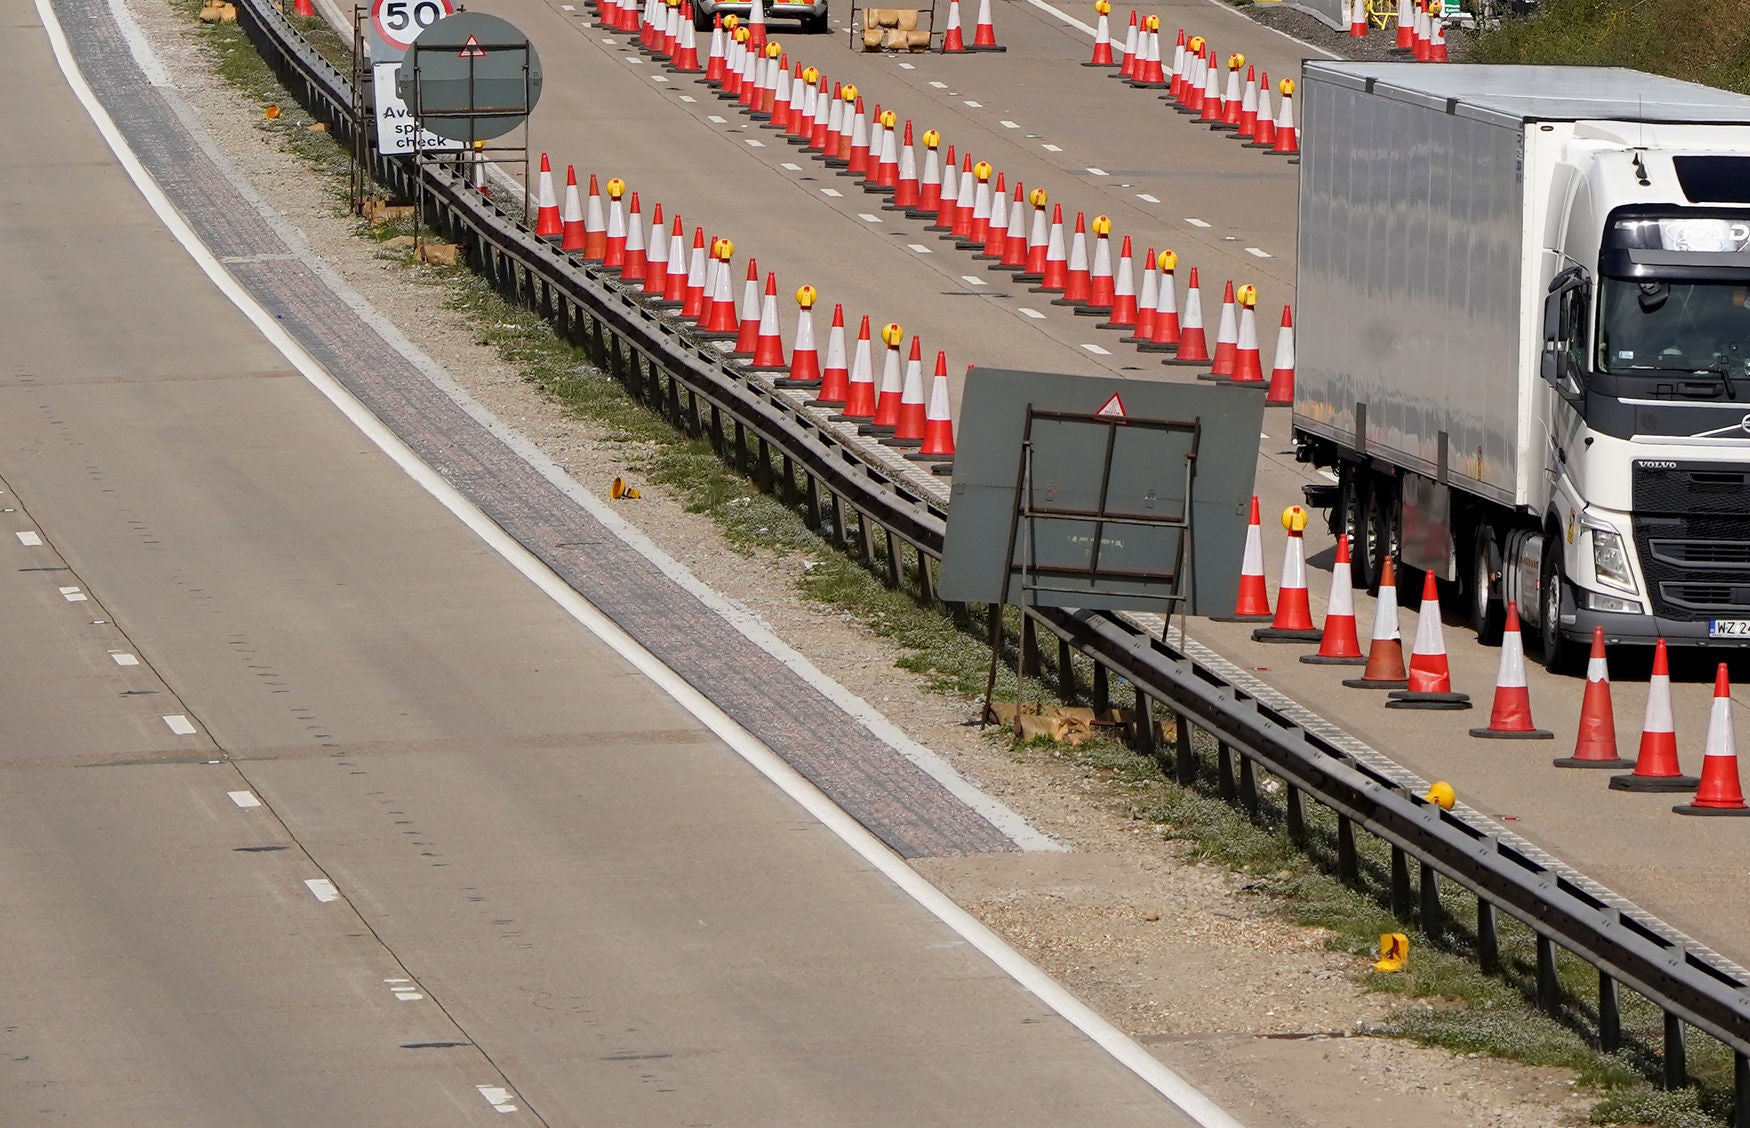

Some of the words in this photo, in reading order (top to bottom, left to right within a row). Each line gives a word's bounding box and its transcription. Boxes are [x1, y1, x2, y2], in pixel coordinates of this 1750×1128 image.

[386, 1, 440, 30] 50
[396, 136, 447, 148] check
[1638, 460, 1677, 469] VOLVO
[1717, 622, 1735, 634] WZ
